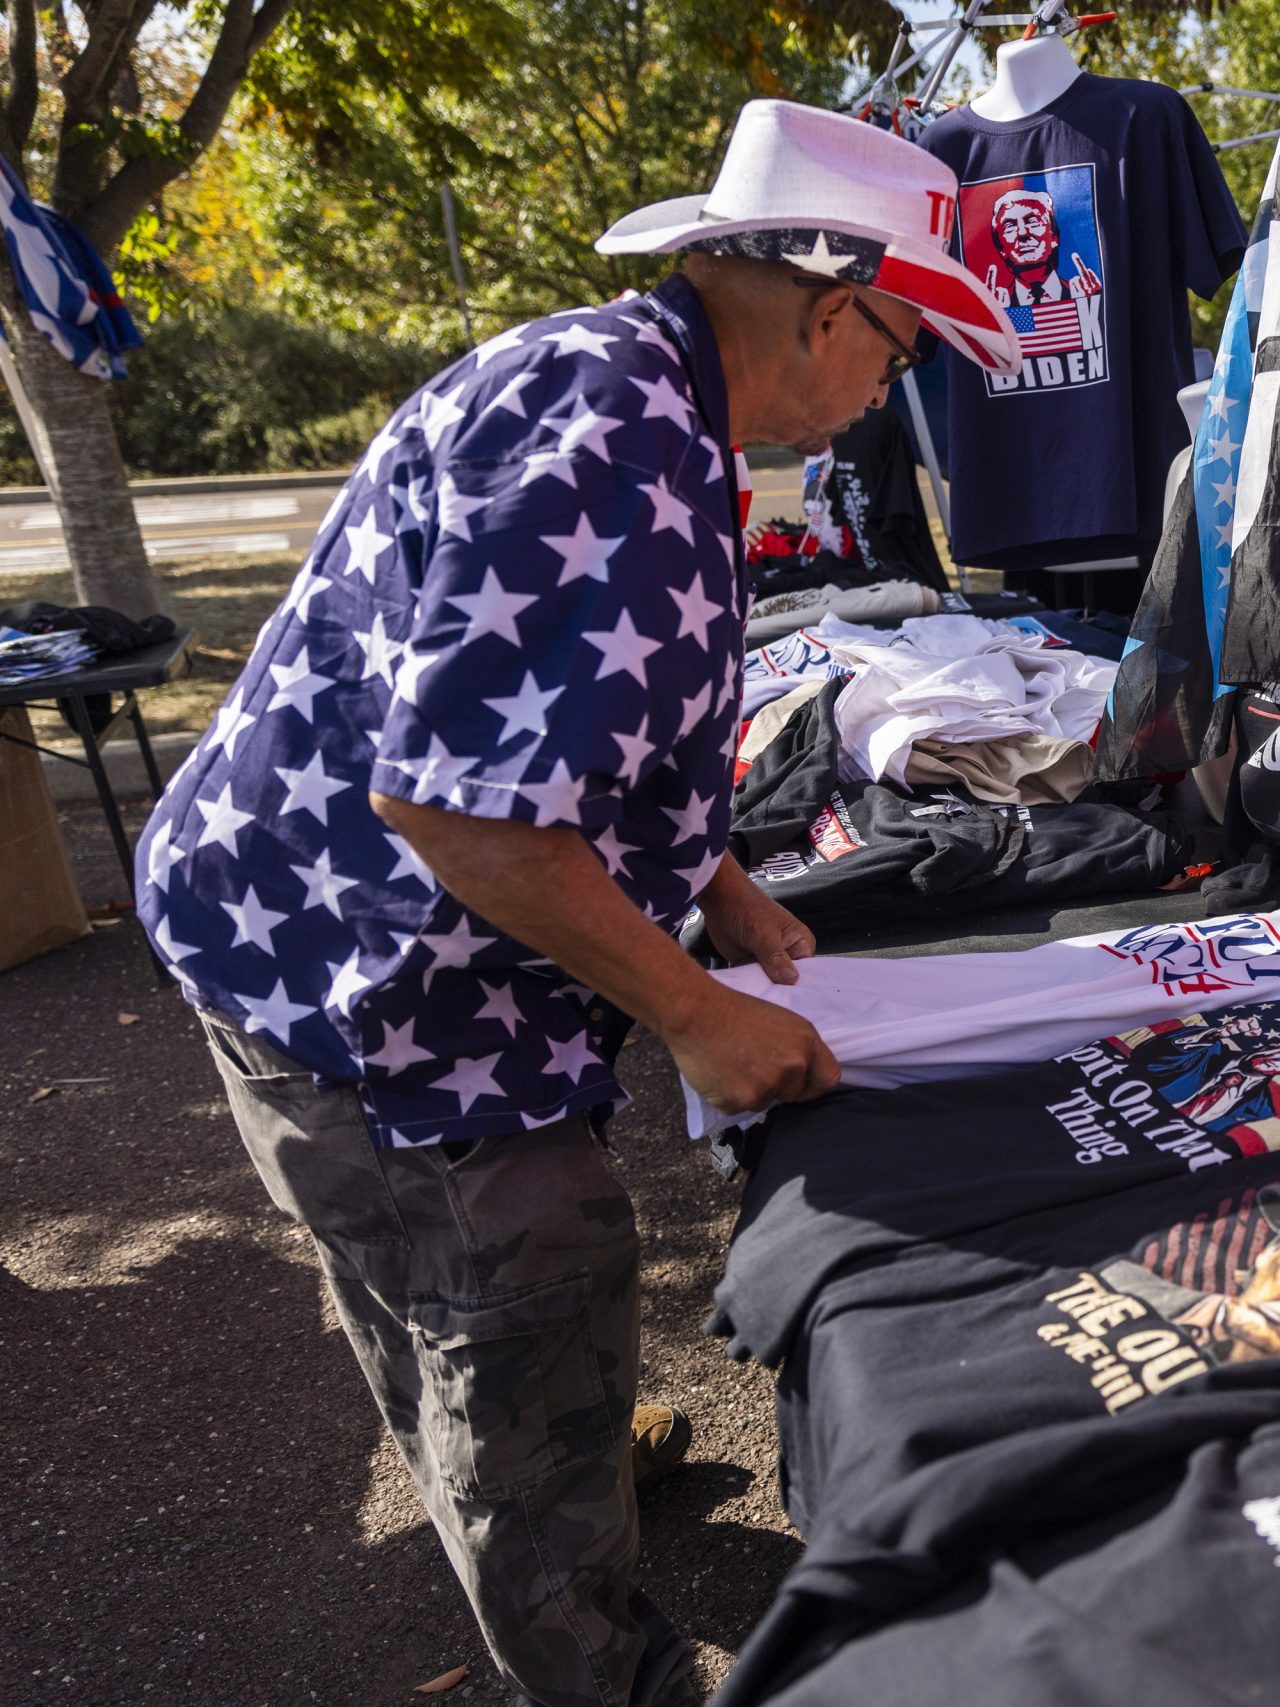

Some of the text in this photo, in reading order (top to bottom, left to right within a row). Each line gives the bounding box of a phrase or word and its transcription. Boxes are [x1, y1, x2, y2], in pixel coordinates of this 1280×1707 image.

[1045, 1086, 1130, 1166] Thing
[1108, 1079, 1153, 1130] On
[1037, 1323, 1070, 1341] &
[1045, 1272, 1148, 1337] THE
